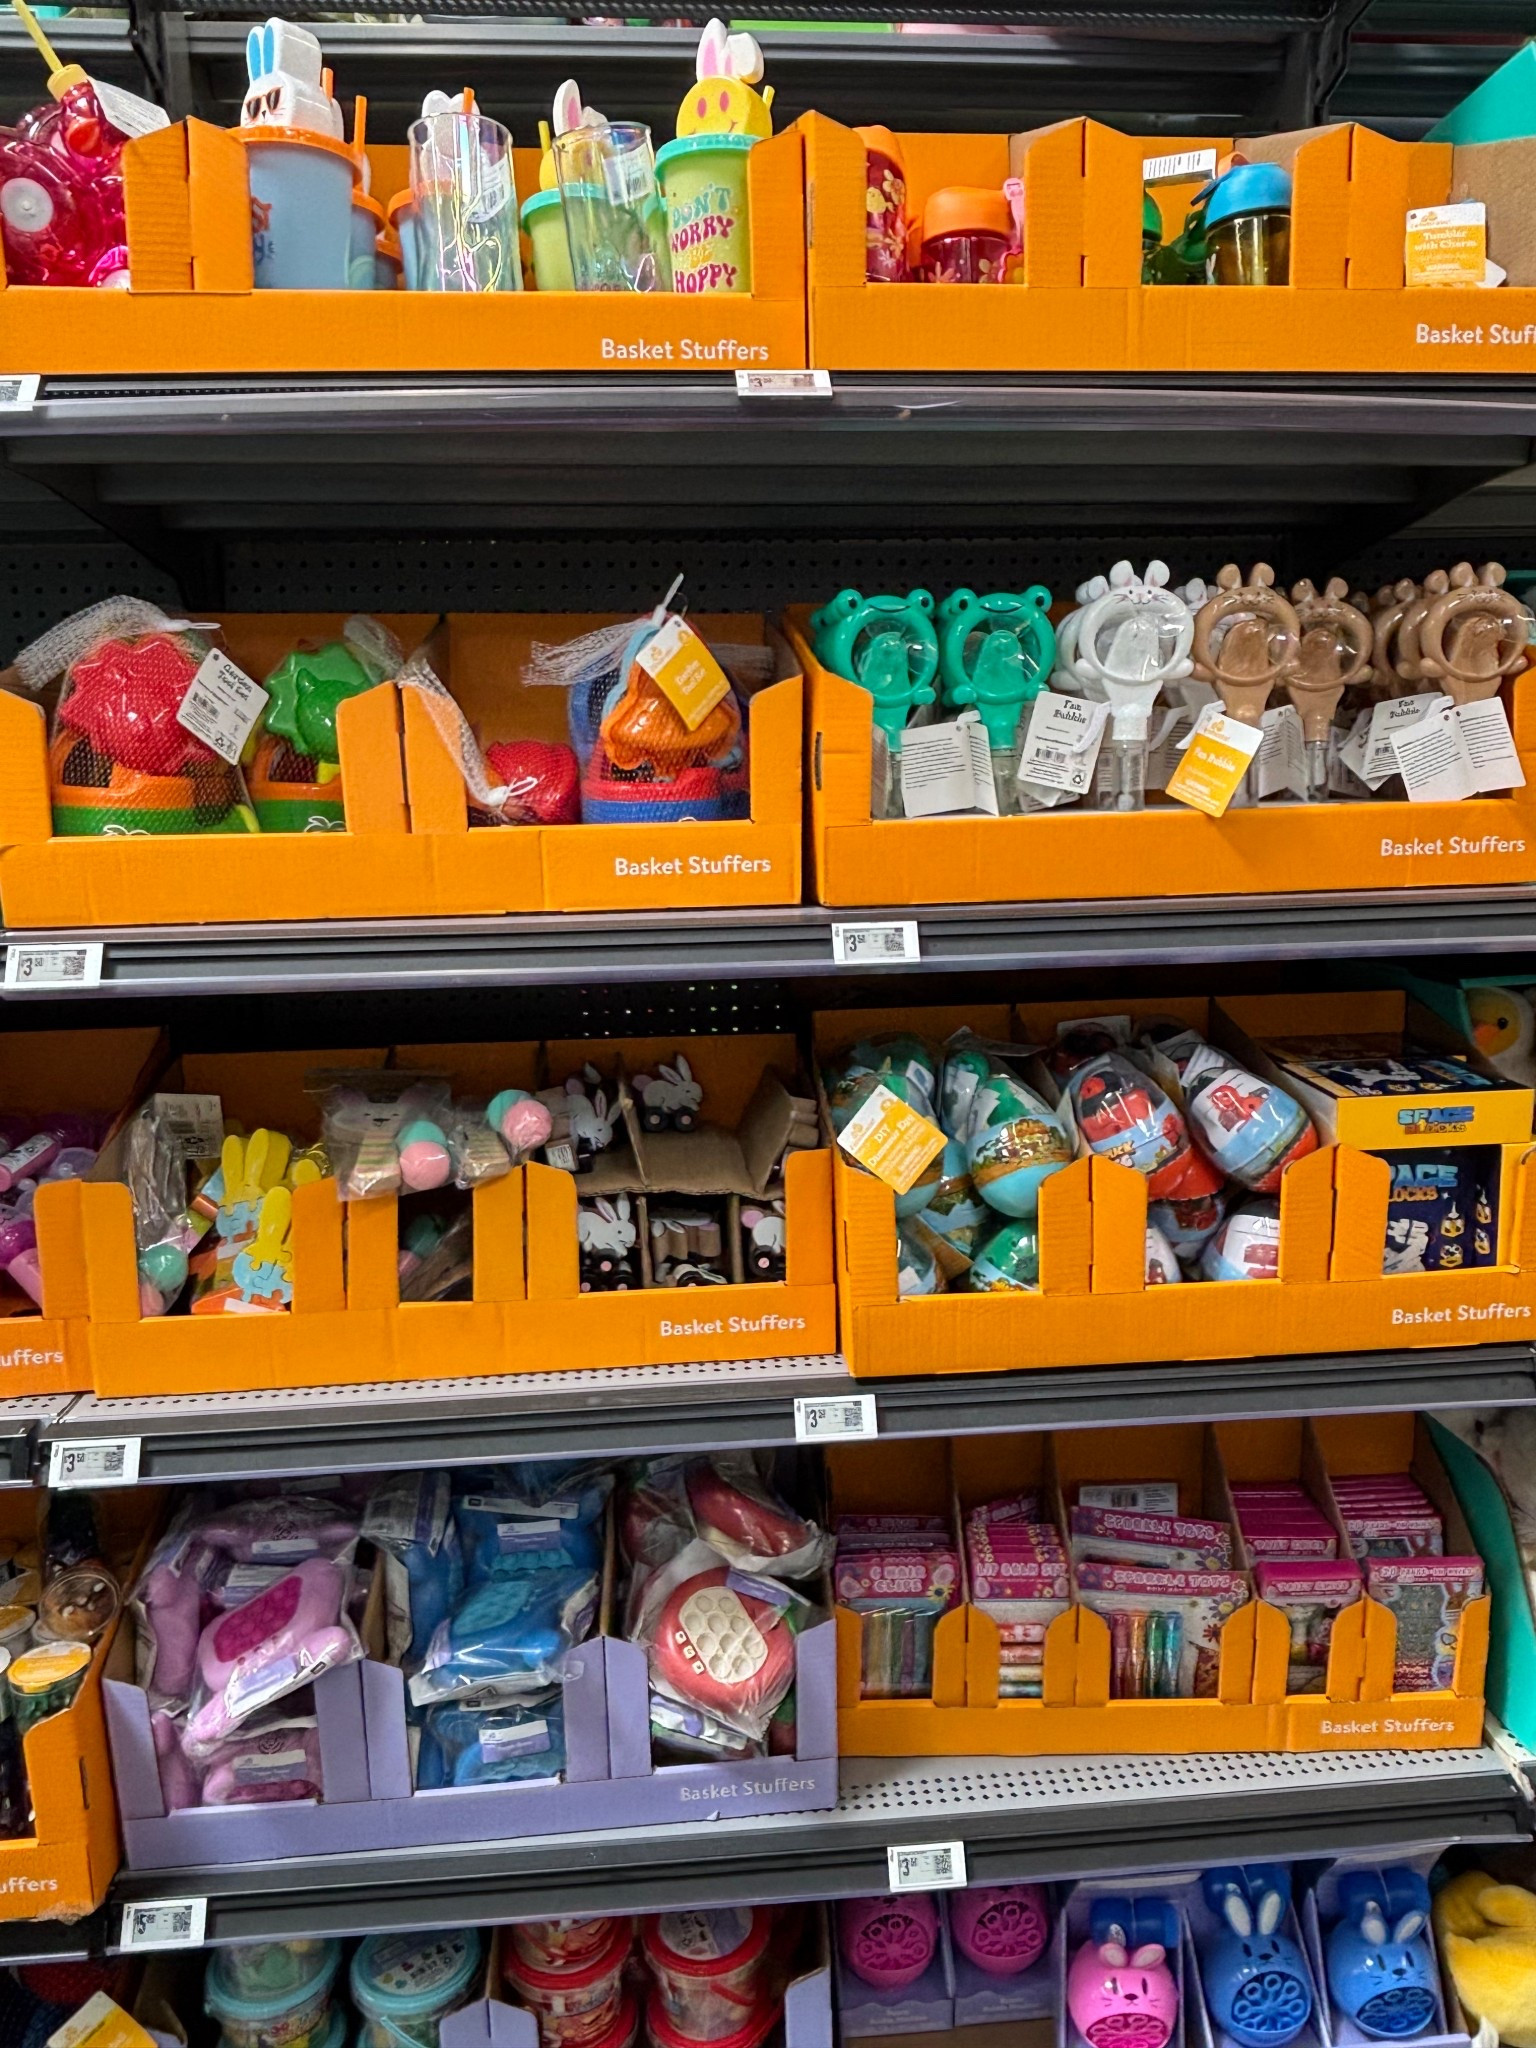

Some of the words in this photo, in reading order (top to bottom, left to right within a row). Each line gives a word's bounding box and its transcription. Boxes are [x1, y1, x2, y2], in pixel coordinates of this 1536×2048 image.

[673, 183, 731, 228] DON'T
[1422, 229, 1468, 241] Tumbler
[1414, 241, 1438, 252] with
[675, 263, 737, 293] HOPPY
[1415, 322, 1484, 344] Basket
[600, 338, 674, 359] Basket
[680, 339, 769, 361] Stuffers
[1380, 837, 1444, 857] Basket
[1448, 835, 1526, 854] Stuffers
[614, 856, 683, 876] Basket
[688, 854, 772, 875] Stuffers
[849, 934, 858, 952] 3
[23, 957, 33, 976] 3
[1397, 1106, 1475, 1126] SPACE
[873, 1123, 891, 1144] DIY
[1390, 1164, 1459, 1190] ACE
[1389, 1186, 1439, 1203] OCKS
[1391, 1306, 1453, 1325] Basket
[1457, 1302, 1532, 1321] Stuffers
[660, 1318, 724, 1337] Basket
[728, 1314, 806, 1333] Stuffers
[0, 1348, 65, 1367] uffers
[809, 1409, 818, 1428] 3
[65, 1453, 75, 1473] 3
[883, 1564, 927, 1580] HAIR
[975, 1562, 1000, 1577] LIP
[1000, 1562, 1040, 1577] BALM
[874, 1579, 923, 1593] CLIPS
[1320, 1719, 1379, 1734] Basket
[1383, 1717, 1455, 1733] Stuffers
[680, 1783, 738, 1801] Basket
[742, 1777, 816, 1796] Stuffers
[902, 1857, 910, 1877] 3
